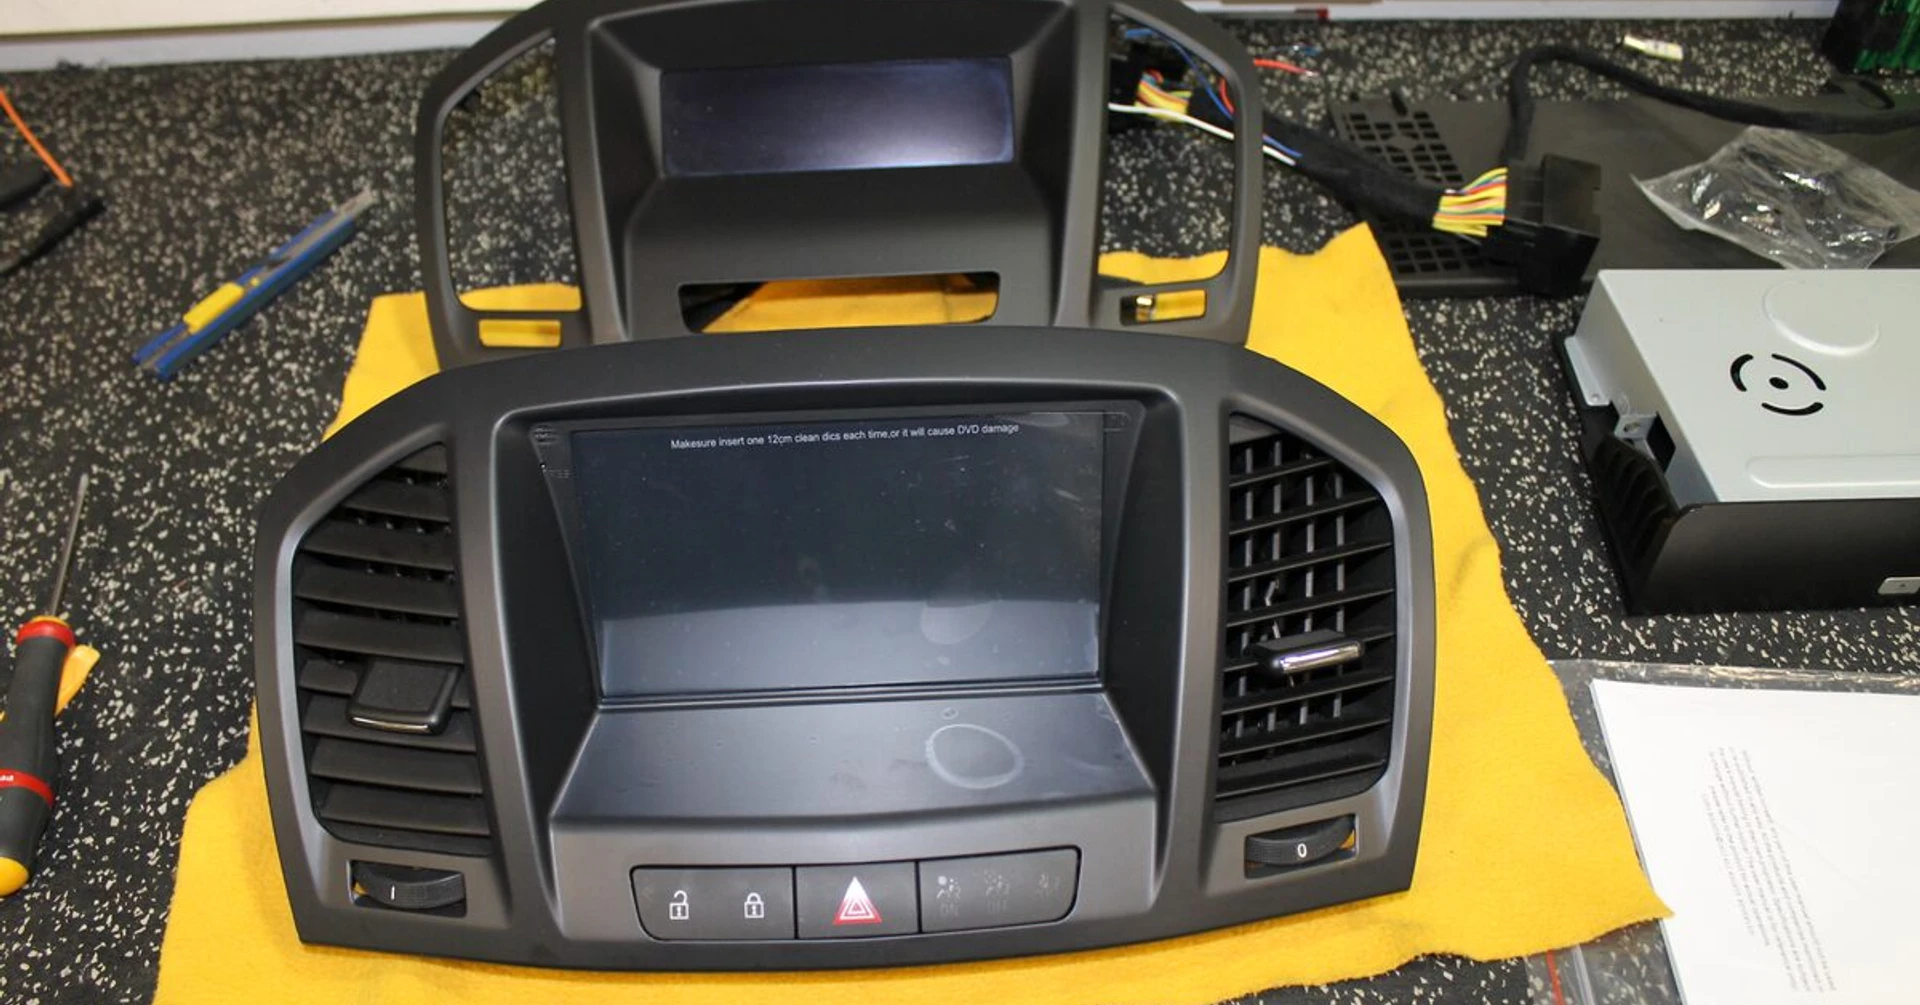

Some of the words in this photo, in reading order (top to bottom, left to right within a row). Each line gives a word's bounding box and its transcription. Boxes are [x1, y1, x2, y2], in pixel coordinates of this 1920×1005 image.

[671, 438, 716, 450] Makesure
[719, 436, 745, 447] insert
[747, 437, 764, 446] one
[768, 434, 793, 444] 12cm
[795, 432, 820, 443] clean
[843, 430, 865, 440] each
[903, 428, 909, 437] it
[910, 427, 925, 436] will
[927, 426, 955, 436] cause
[957, 424, 980, 434] DVD
[981, 423, 1019, 436] damage
